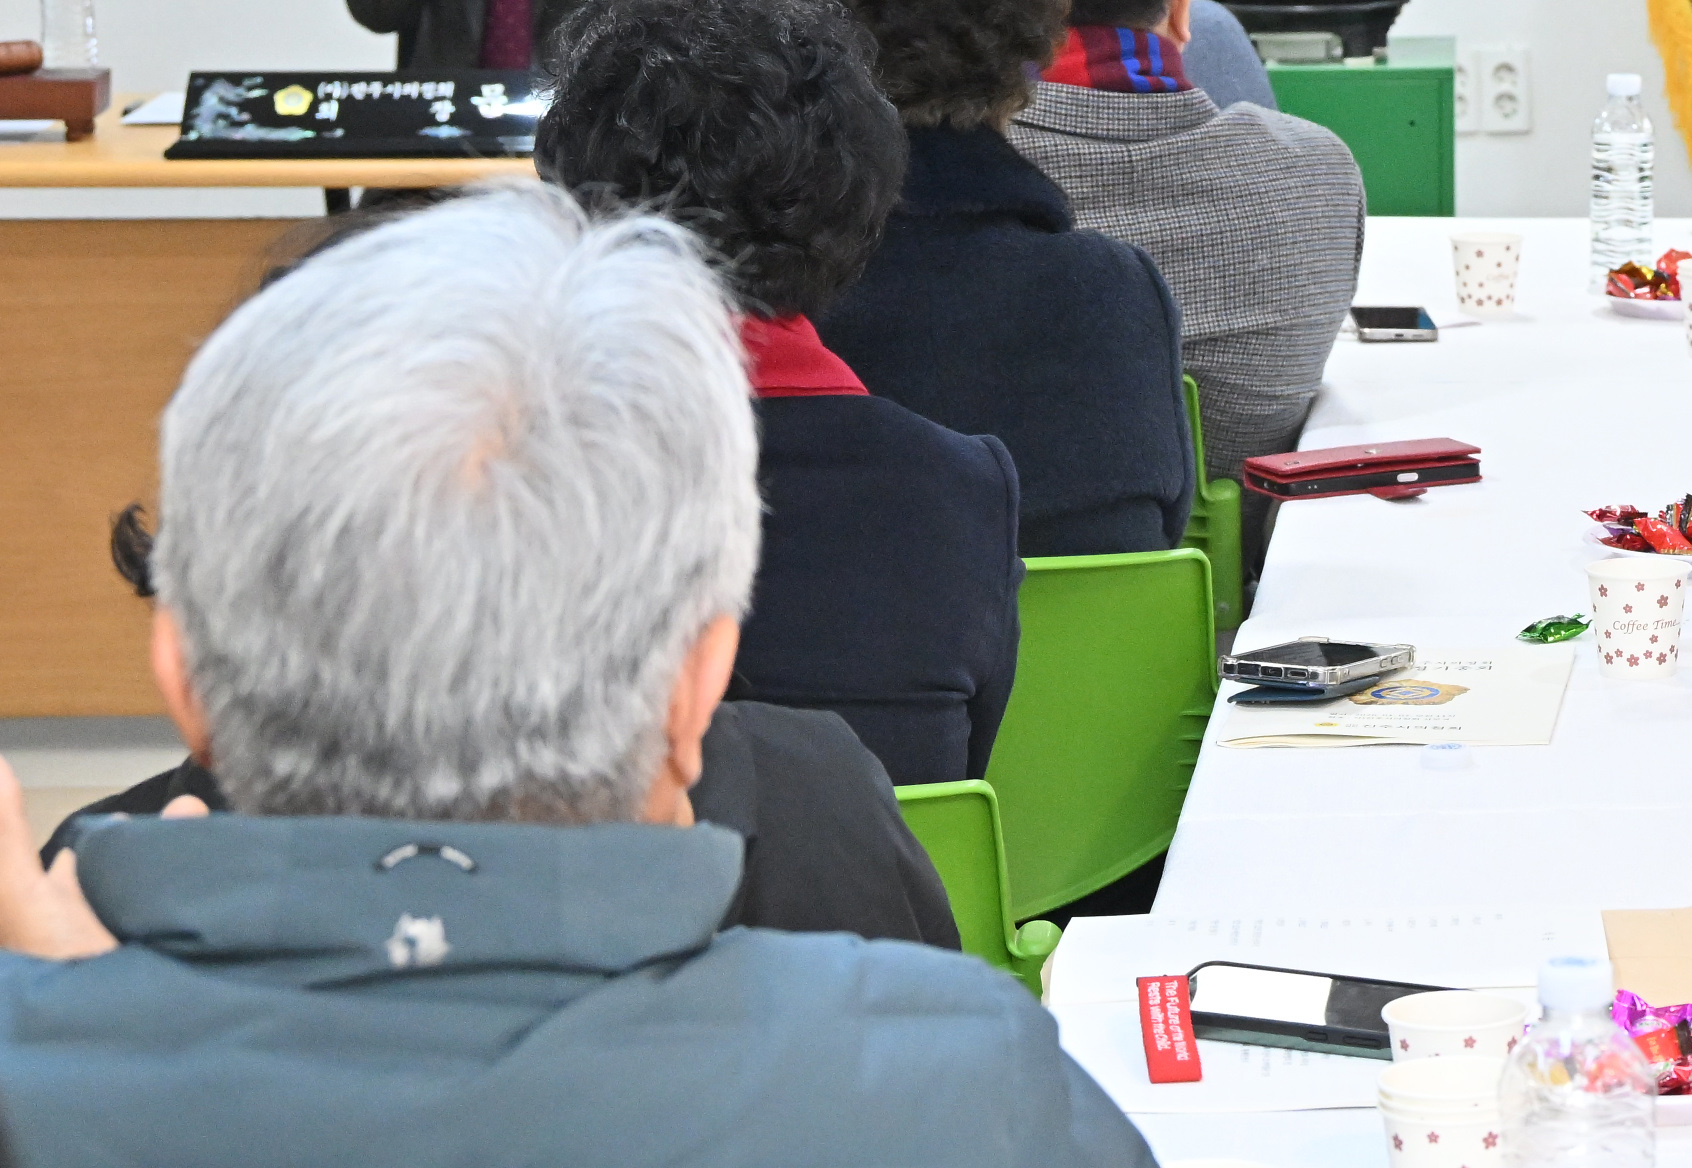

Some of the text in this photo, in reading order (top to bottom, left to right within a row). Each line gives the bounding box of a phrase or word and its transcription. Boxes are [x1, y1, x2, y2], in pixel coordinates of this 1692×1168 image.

[1612, 619, 1649, 634] Coffee
[1147, 982, 1161, 1004] Rests
[1165, 980, 1178, 996] The
[1150, 1005, 1164, 1023] with
[1166, 997, 1180, 1024] Future
